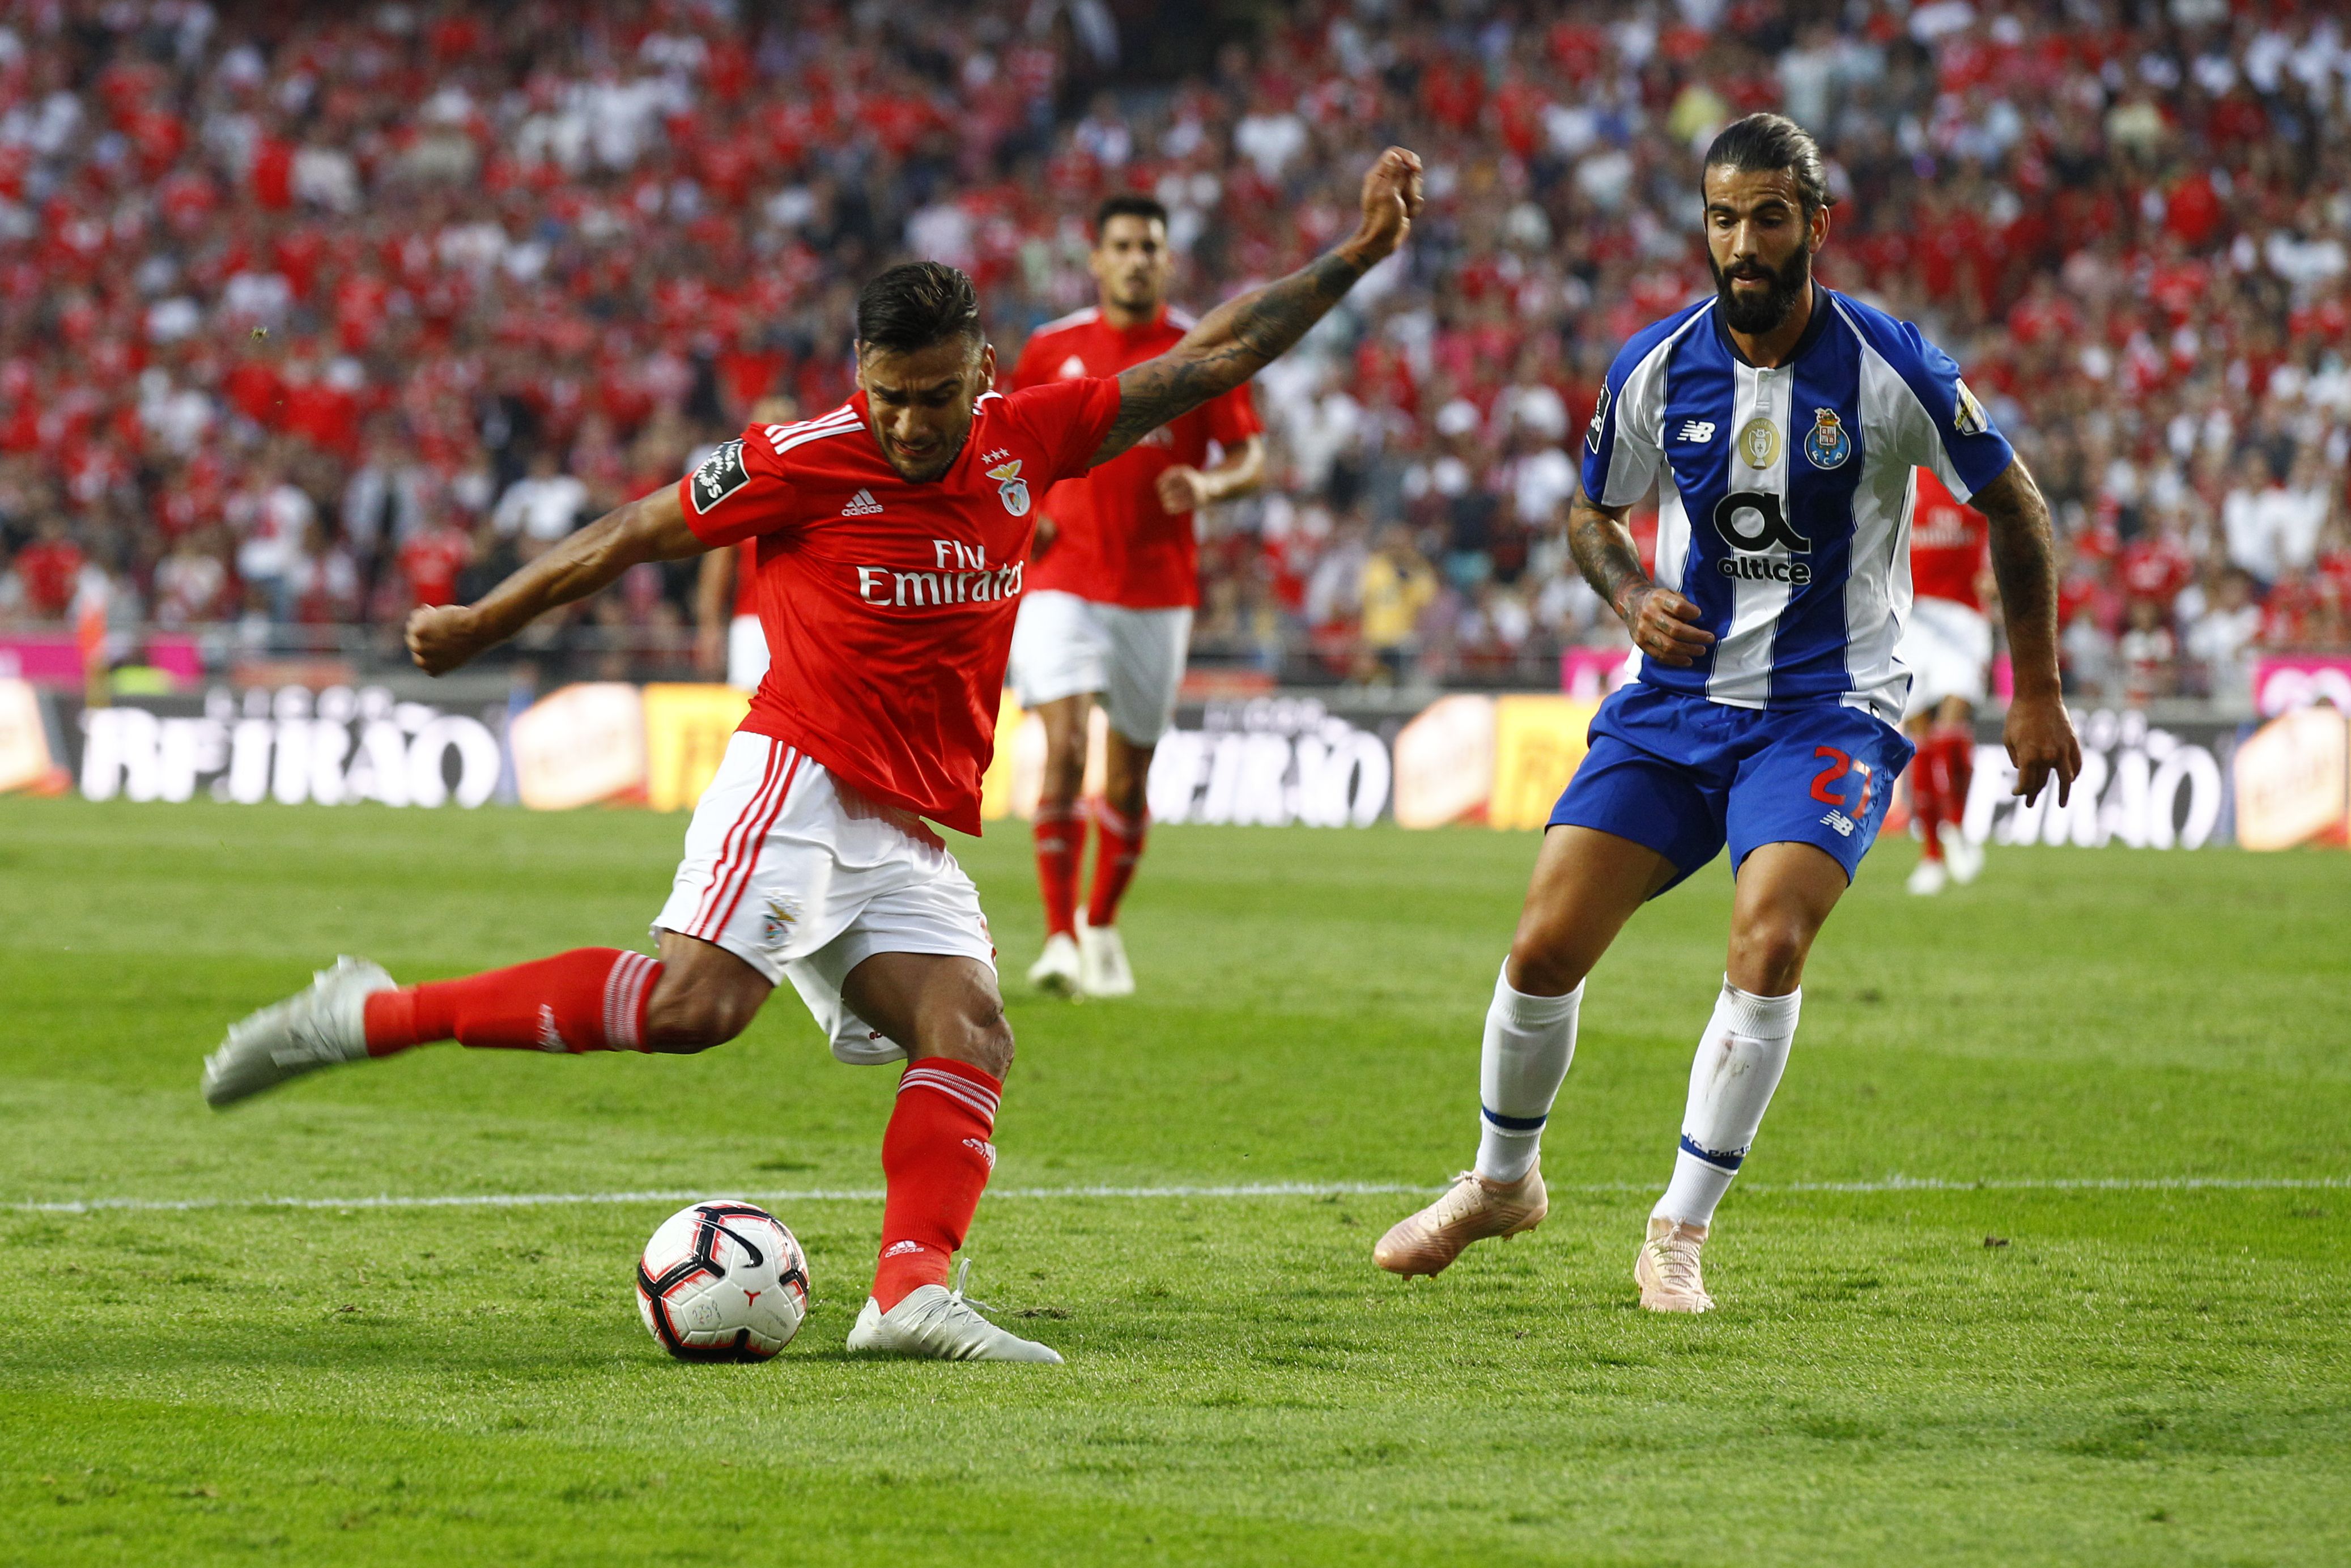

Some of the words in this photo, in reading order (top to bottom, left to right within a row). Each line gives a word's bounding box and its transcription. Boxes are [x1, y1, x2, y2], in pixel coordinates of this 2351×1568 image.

[841, 504, 884, 517] adidas
[933, 539, 985, 571] Fly
[1717, 555, 1811, 585] altice
[856, 560, 1024, 606] Emirates
[885, 1247, 925, 1258] adidas
